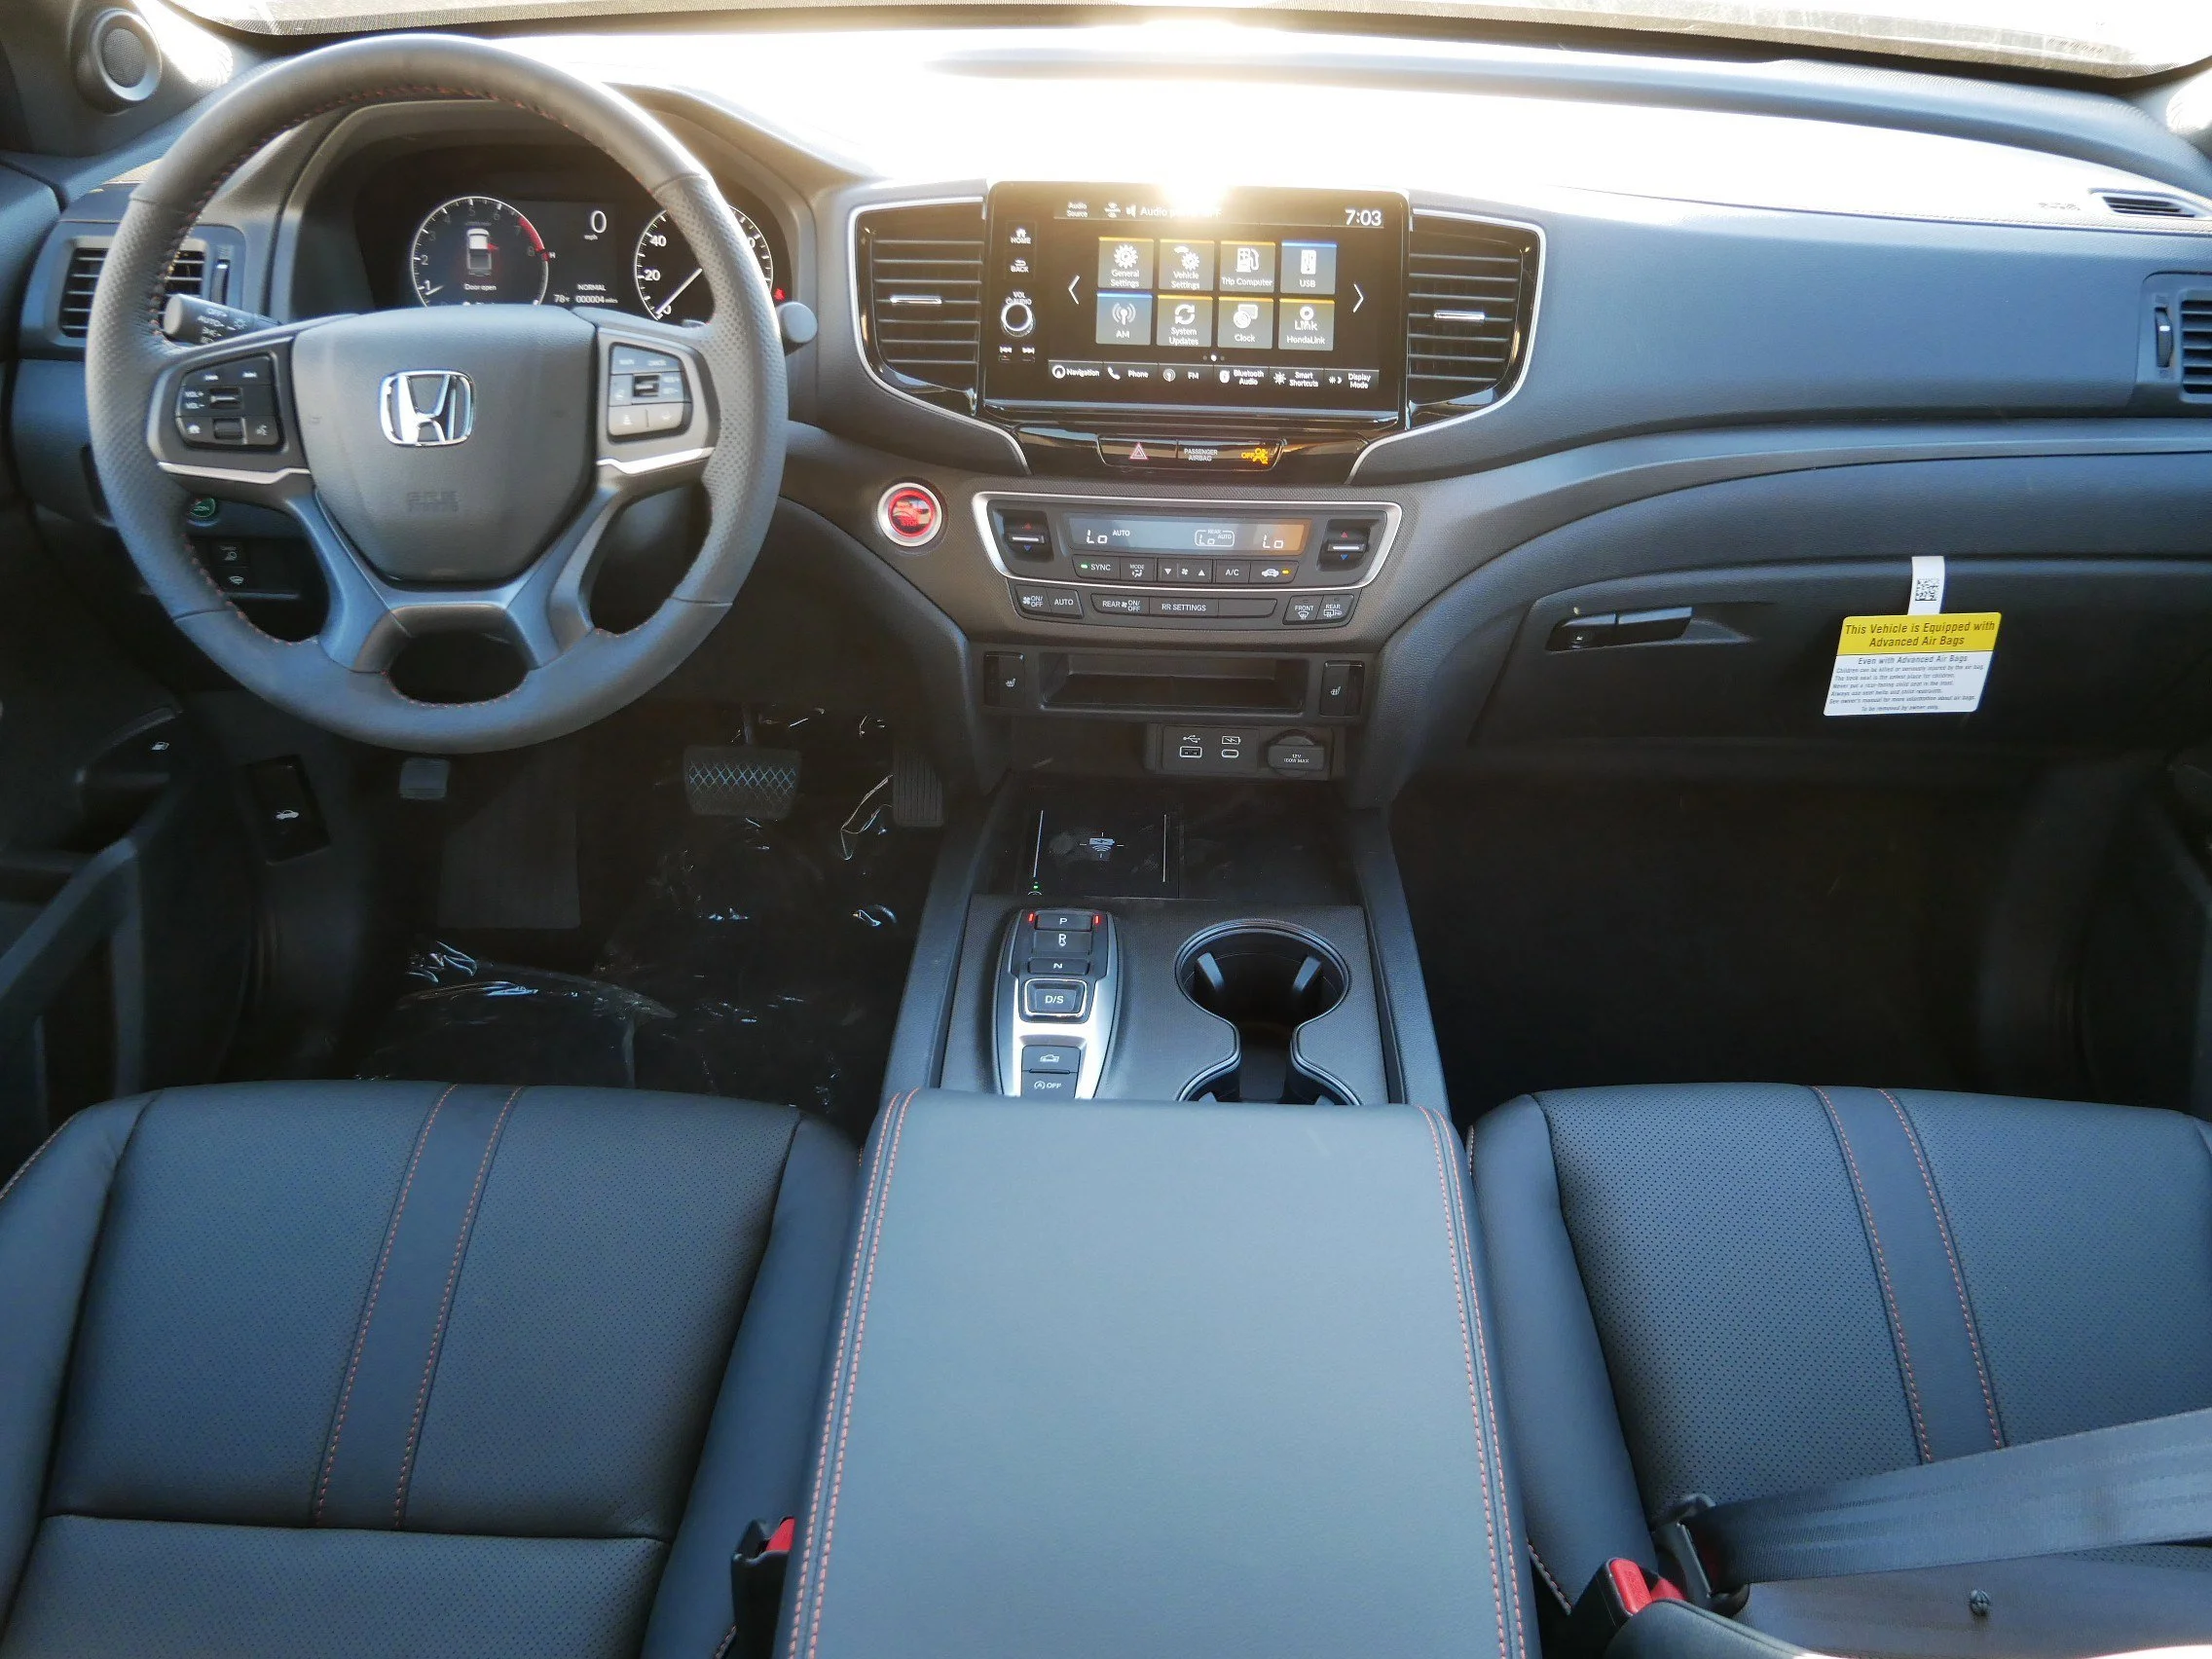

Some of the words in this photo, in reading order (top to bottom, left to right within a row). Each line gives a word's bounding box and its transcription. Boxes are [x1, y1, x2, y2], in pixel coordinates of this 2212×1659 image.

[1140, 206, 1167, 217] Audio
[590, 210, 608, 234] 0
[1345, 208, 1382, 227] 7:03
[649, 235, 667, 247] 40
[421, 255, 428, 265] 2
[644, 269, 661, 281] 20
[1111, 270, 1140, 278] General
[424, 279, 430, 290] 1
[1110, 278, 1140, 288] Settings
[1171, 280, 1200, 290] Settings
[1221, 276, 1235, 286] Trip
[1235, 277, 1273, 287] Computer
[1299, 279, 1316, 288] USB
[1116, 330, 1130, 339] AM
[1170, 327, 1198, 336] System
[1168, 337, 1199, 347] Updates
[1234, 334, 1256, 343] Clock
[1286, 335, 1325, 345] HondaLink
[1066, 368, 1100, 378] Navigation
[1127, 369, 1149, 378] Phone
[1188, 371, 1199, 380] FM
[1234, 369, 1265, 378] Bluetooth
[1295, 371, 1313, 380] Smart
[1347, 373, 1372, 383] Display
[1349, 381, 1369, 389] Mode
[1240, 451, 1254, 460] OFF
[1086, 529, 1108, 544] Lo
[1263, 535, 1284, 549] Lo
[1846, 624, 1866, 635] This
[1869, 624, 1907, 634] Vehicle
[1910, 623, 1920, 633] is
[1923, 622, 1971, 634] Equipped
[1973, 620, 1995, 631] with
[1869, 637, 1919, 647] Advanced
[1921, 636, 1937, 645] Air
[1939, 635, 1966, 646] Bags
[1897, 655, 1934, 664] Advanced
[1949, 654, 1968, 663] Bags
[1058, 933, 1066, 942] R
[1045, 995, 1064, 1004] D/S
